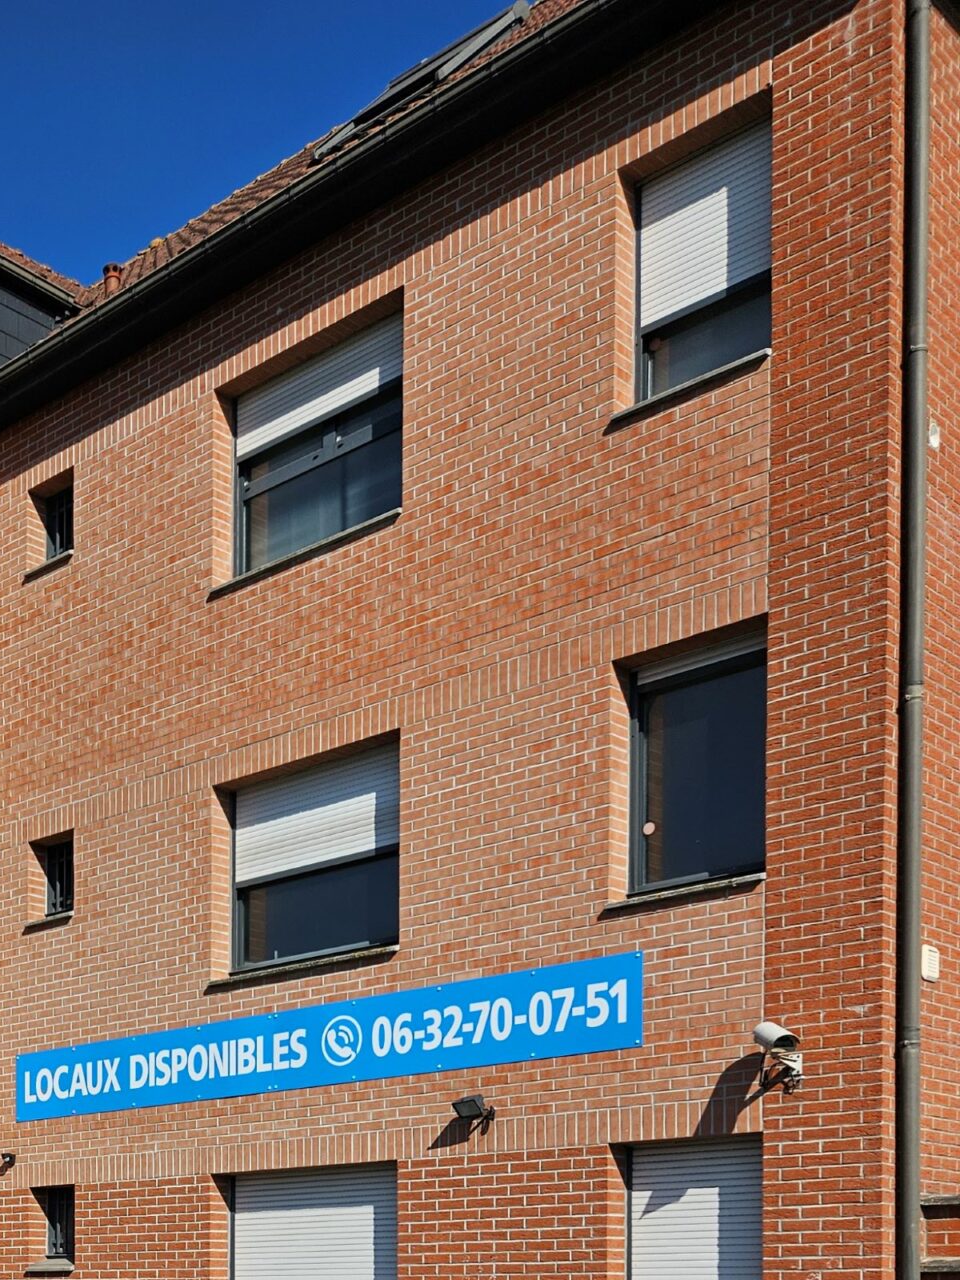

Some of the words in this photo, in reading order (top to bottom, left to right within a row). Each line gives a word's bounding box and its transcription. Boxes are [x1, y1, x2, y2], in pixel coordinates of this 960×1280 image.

[24, 1056, 121, 1103] LOCAUX
[129, 1028, 308, 1090] DISPONIBLES
[371, 979, 628, 1057] 06-32-70-07-51
